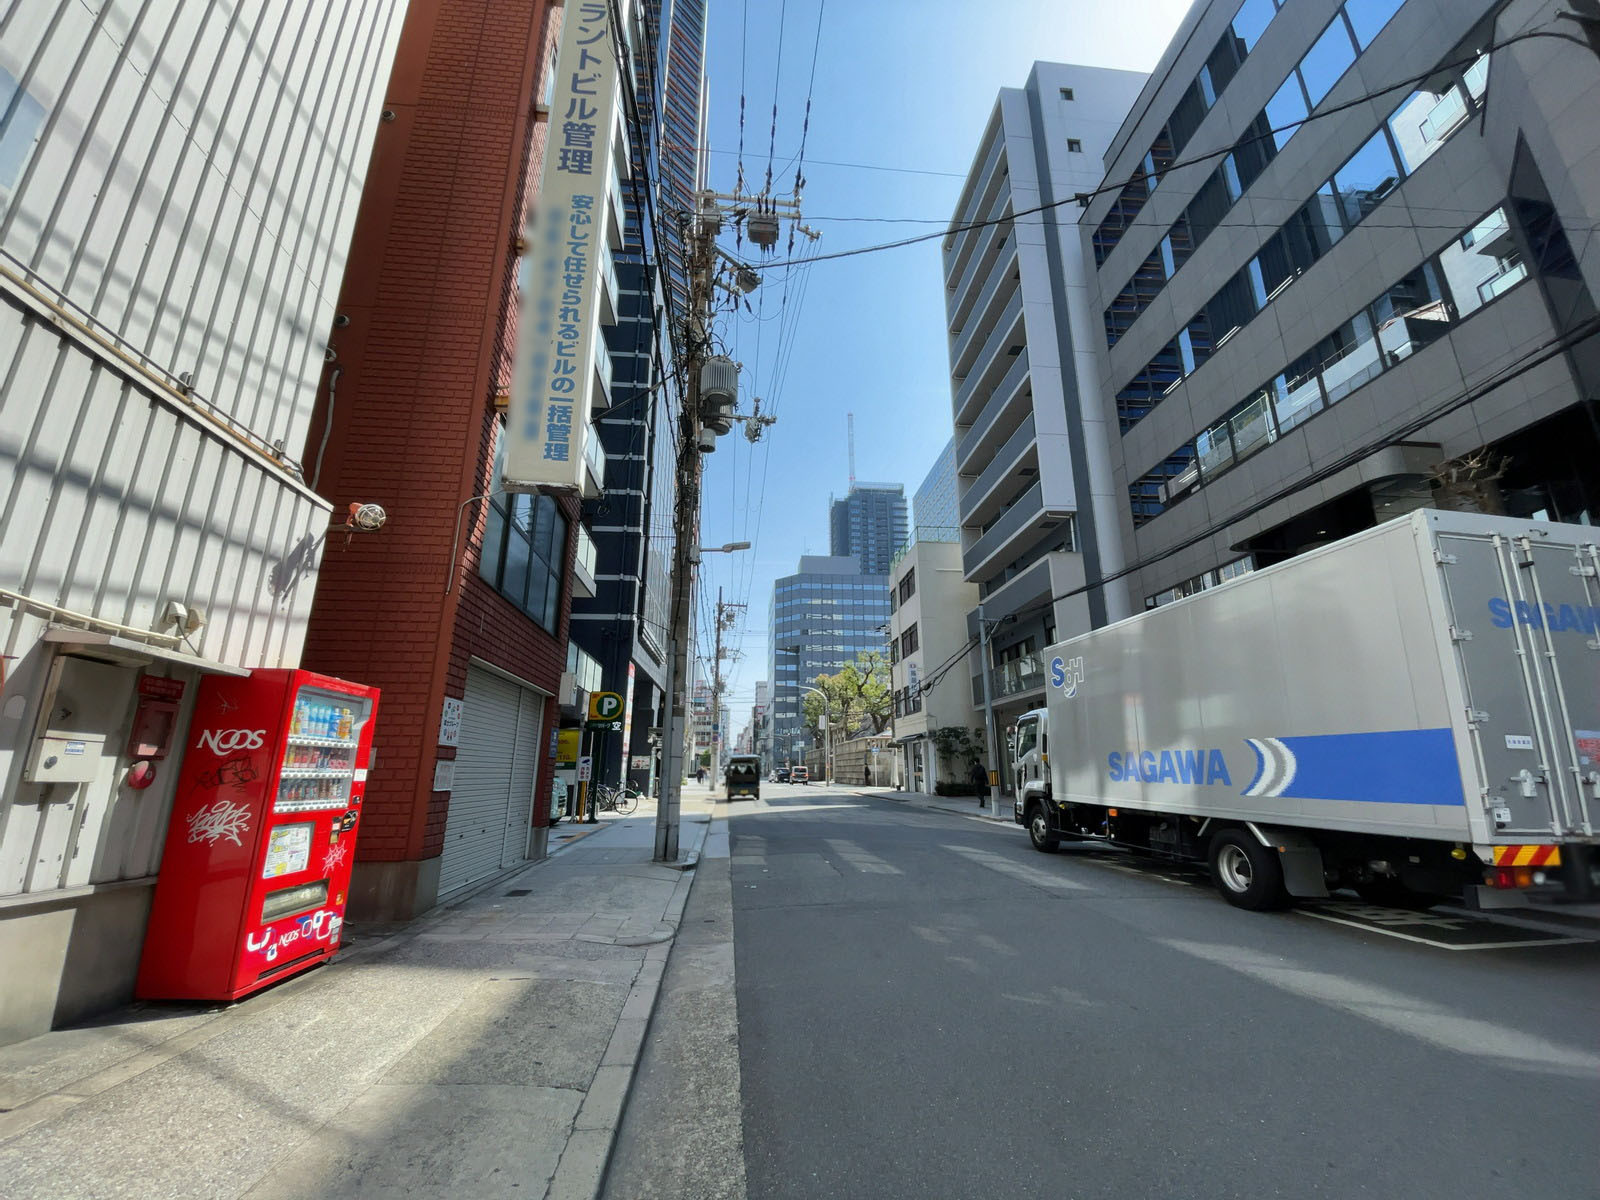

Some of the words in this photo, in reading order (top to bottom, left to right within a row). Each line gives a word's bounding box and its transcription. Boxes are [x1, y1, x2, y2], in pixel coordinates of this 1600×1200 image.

[557, 3, 606, 175] ラントビル管理
[543, 194, 594, 462] 安心して任せられるビルの一括管理
[602, 697, 617, 715] P
[196, 729, 266, 756] NOOS
[1108, 749, 1232, 786] SAGAWA
